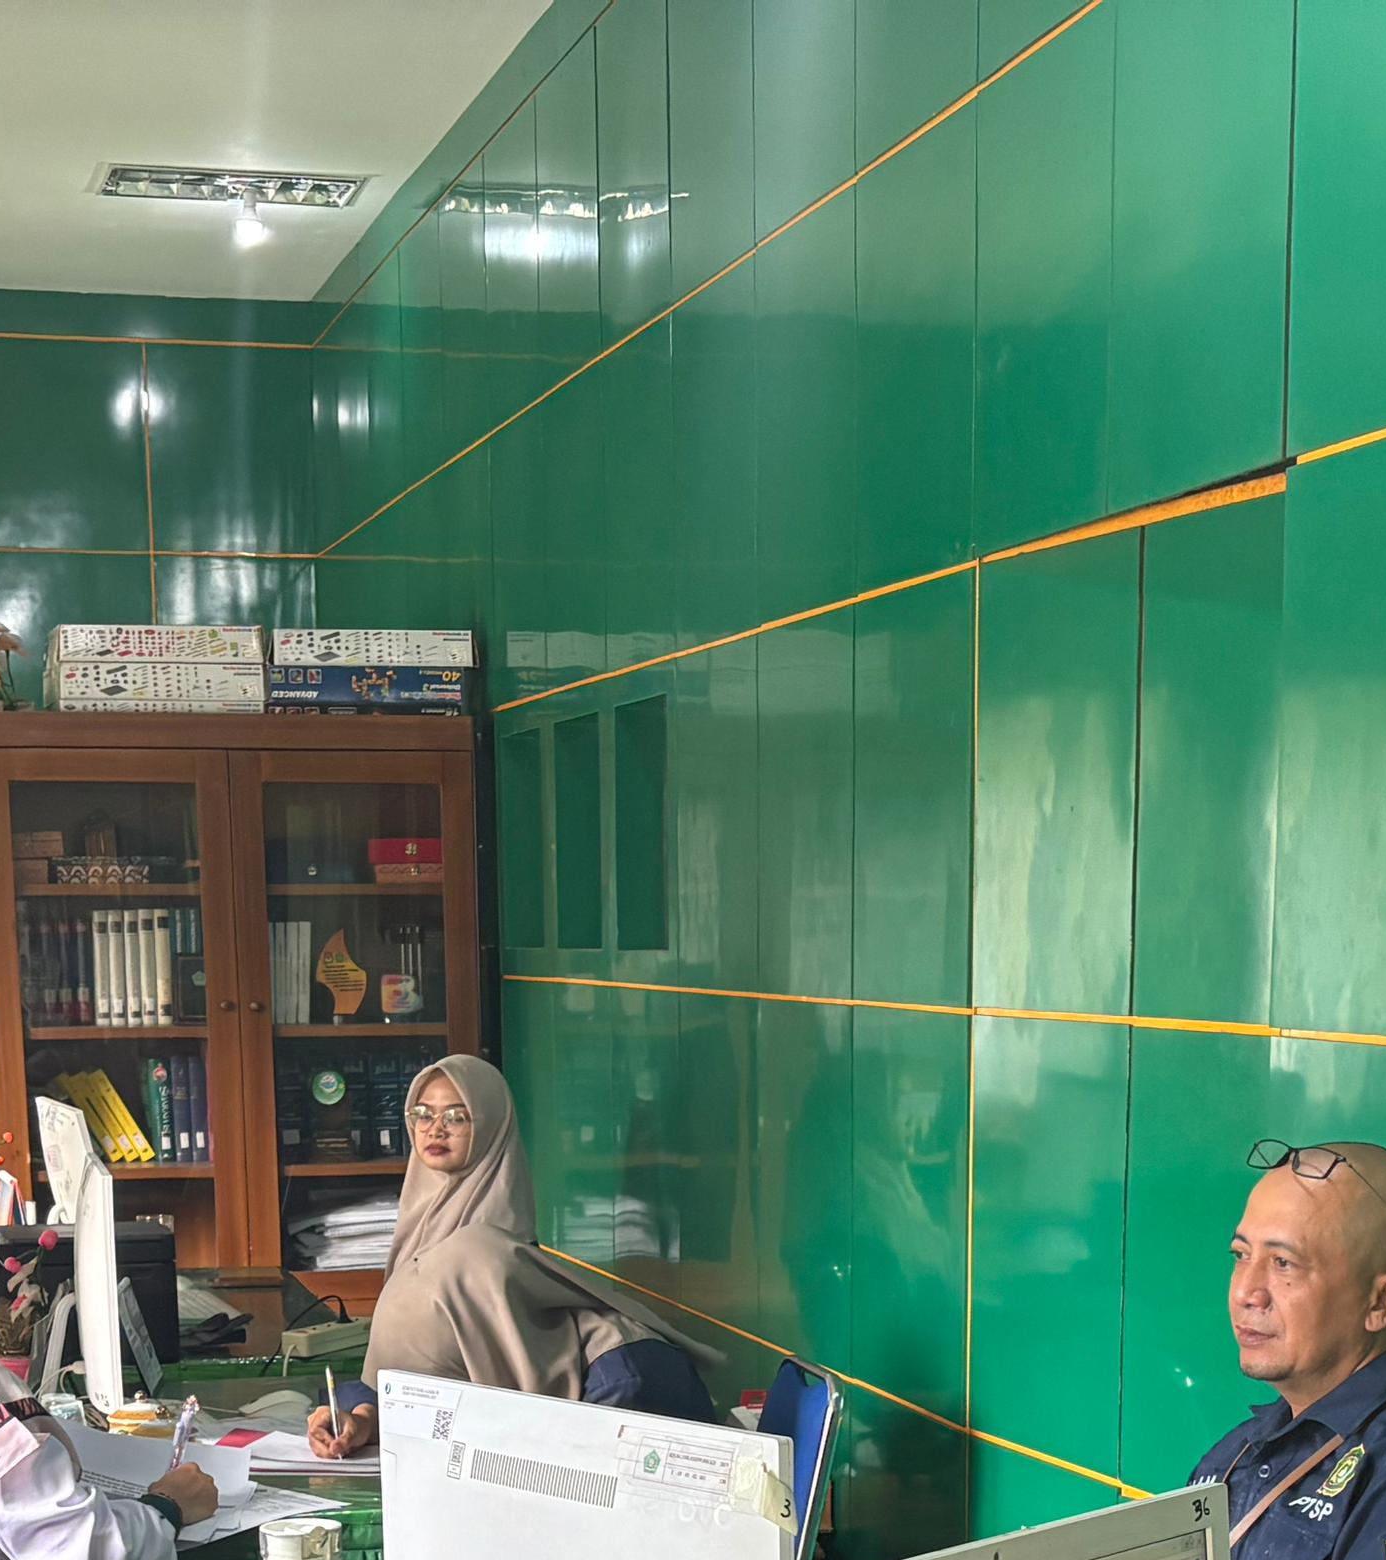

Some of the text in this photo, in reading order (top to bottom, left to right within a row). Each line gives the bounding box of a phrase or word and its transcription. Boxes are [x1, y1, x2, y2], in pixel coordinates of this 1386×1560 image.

[271, 690, 319, 698] ADVANCED
[780, 1499, 791, 1518] 3
[1288, 1496, 1334, 1522] PTSP
